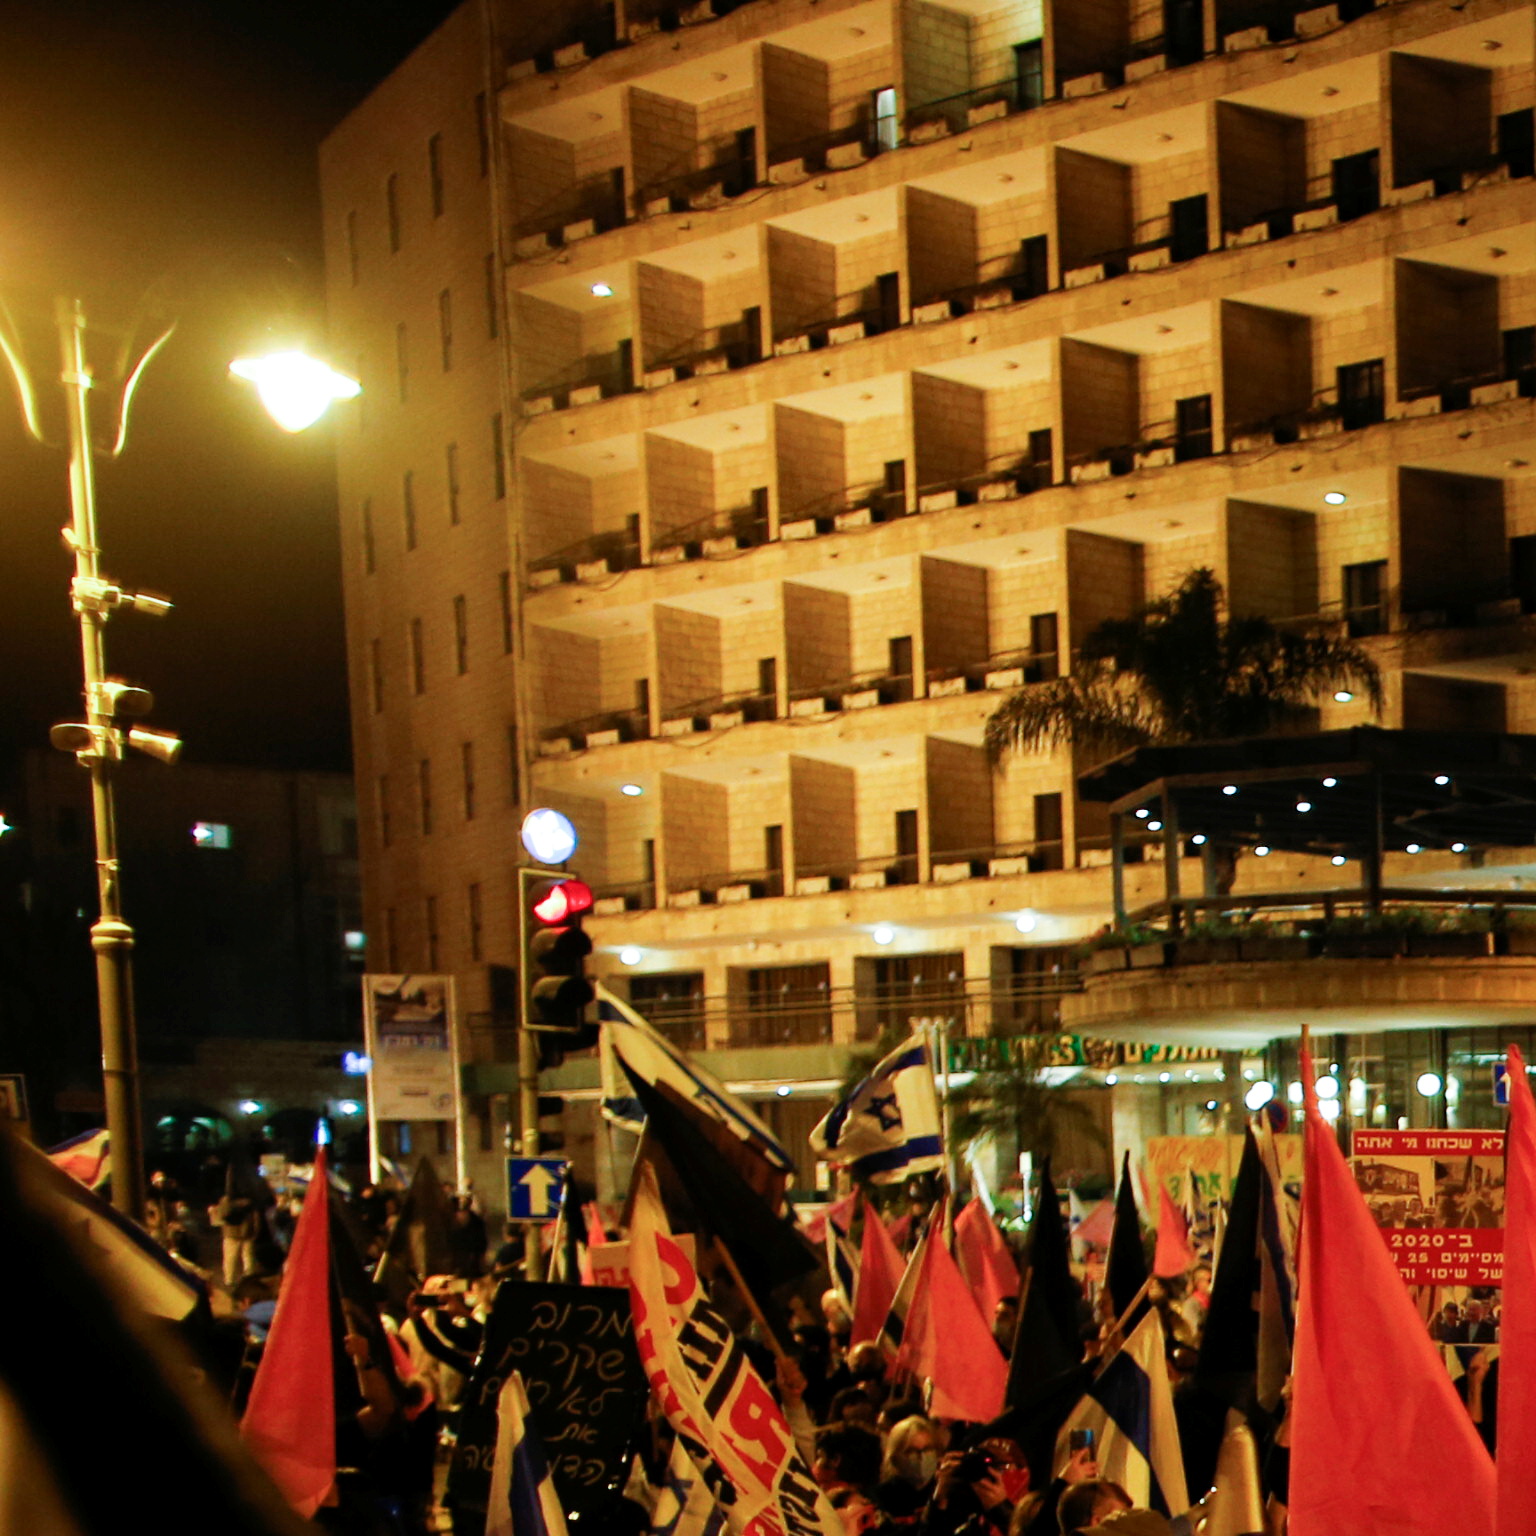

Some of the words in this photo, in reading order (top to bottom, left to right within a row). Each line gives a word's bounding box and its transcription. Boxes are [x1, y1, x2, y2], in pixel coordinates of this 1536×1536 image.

[1357, 1136, 1393, 1150] אתה
[1401, 1136, 1419, 1150] מי
[1426, 1136, 1473, 1150] שכחנו
[1481, 1136, 1505, 1150] לא
[1407, 1252, 1428, 1266] 25
[1440, 1252, 1505, 1266] מסיימים
[1478, 1264, 1504, 1279] של
[527, 1300, 634, 1339] מרוב
[494, 1336, 627, 1391] שקרים
